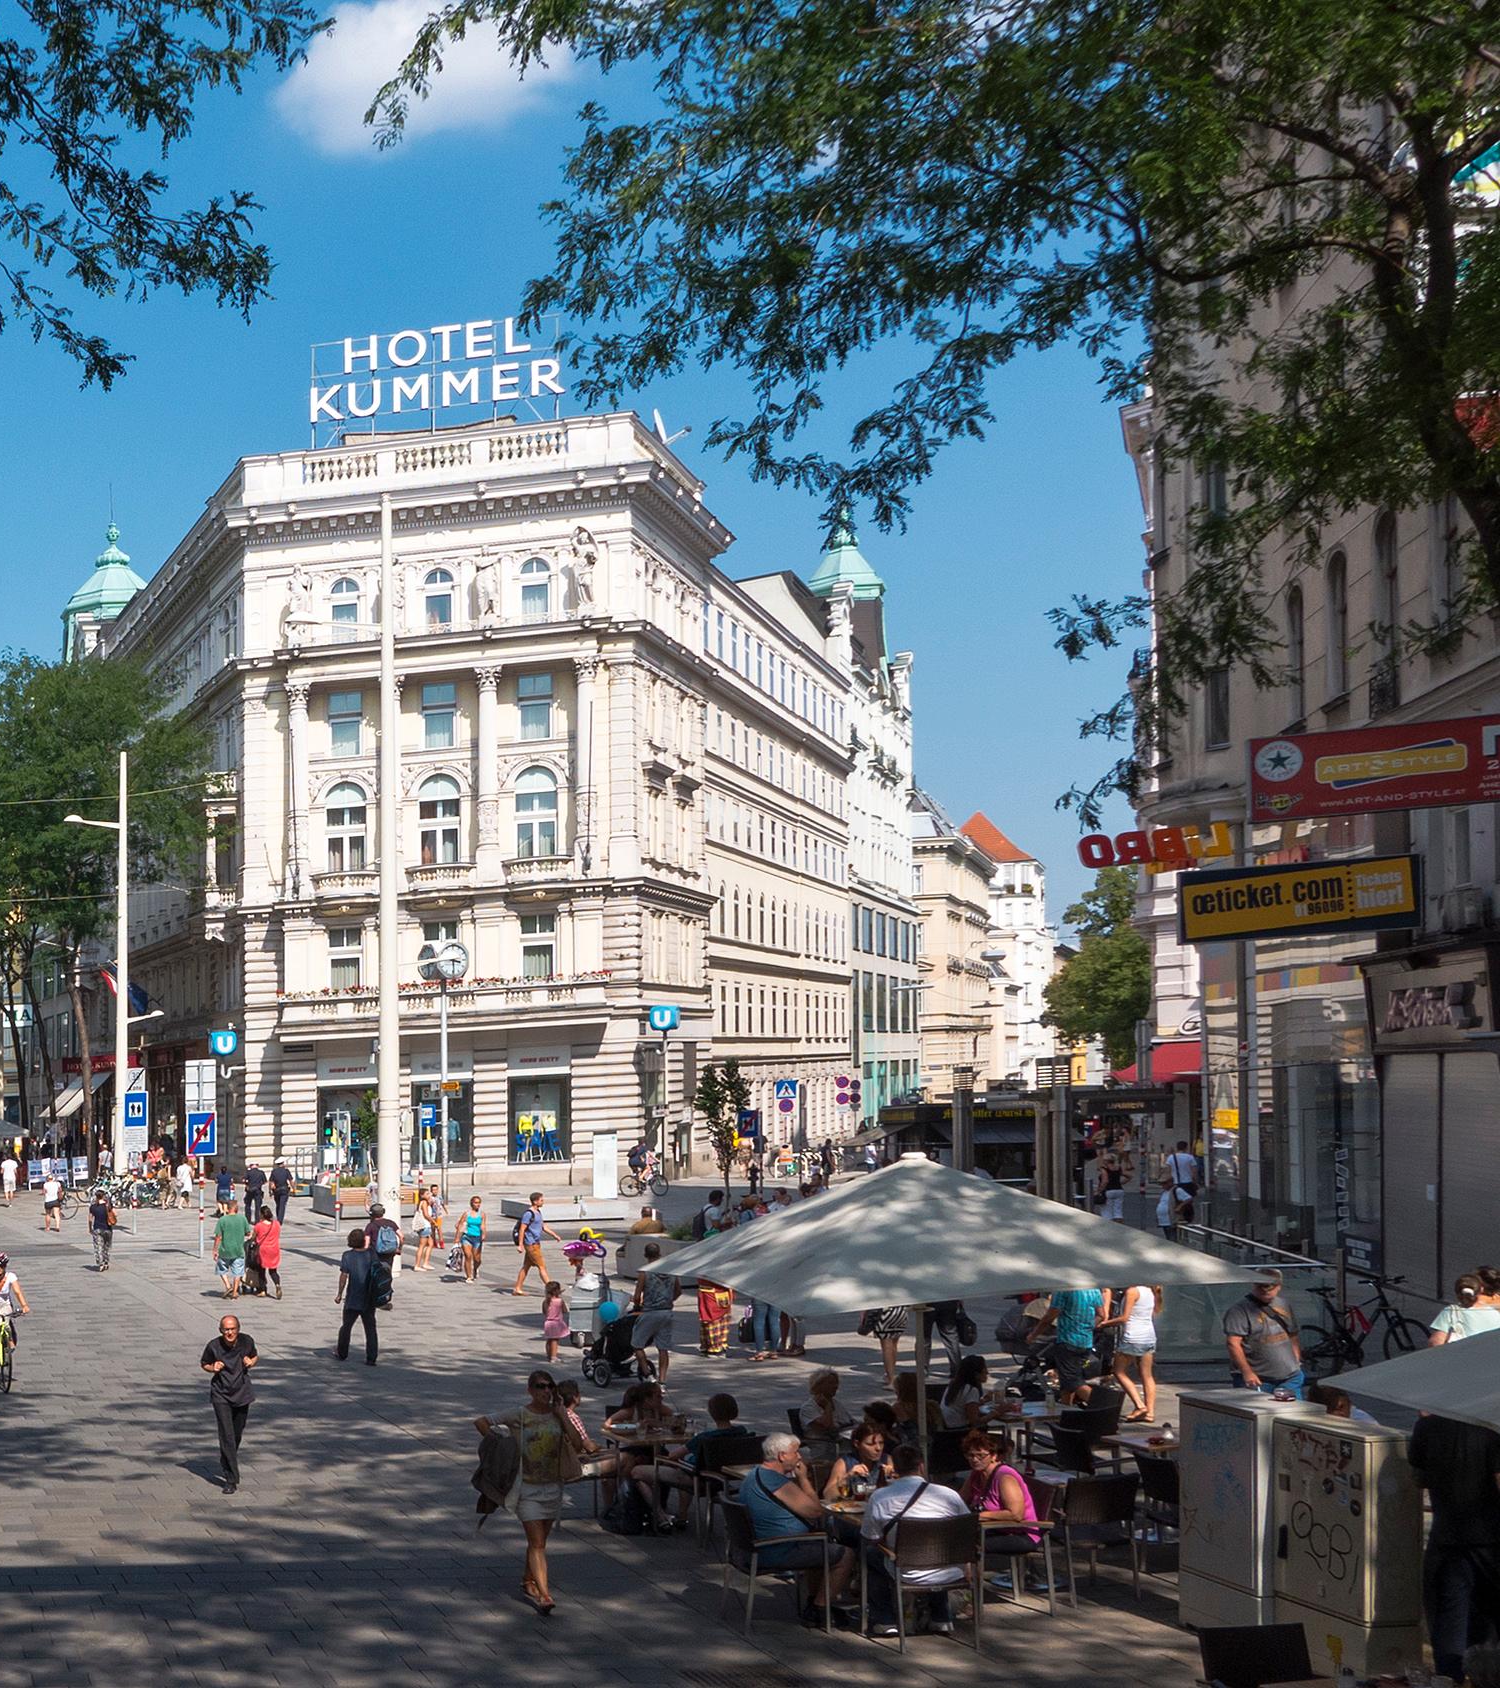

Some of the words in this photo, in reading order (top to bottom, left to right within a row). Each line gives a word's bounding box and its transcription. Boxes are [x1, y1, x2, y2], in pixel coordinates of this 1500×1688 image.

[344, 317, 531, 374] HOTEL
[310, 359, 566, 423] KUMMER
[654, 1009, 671, 1028] U
[217, 1035, 233, 1051] U
[424, 1087, 461, 1098] SAE
